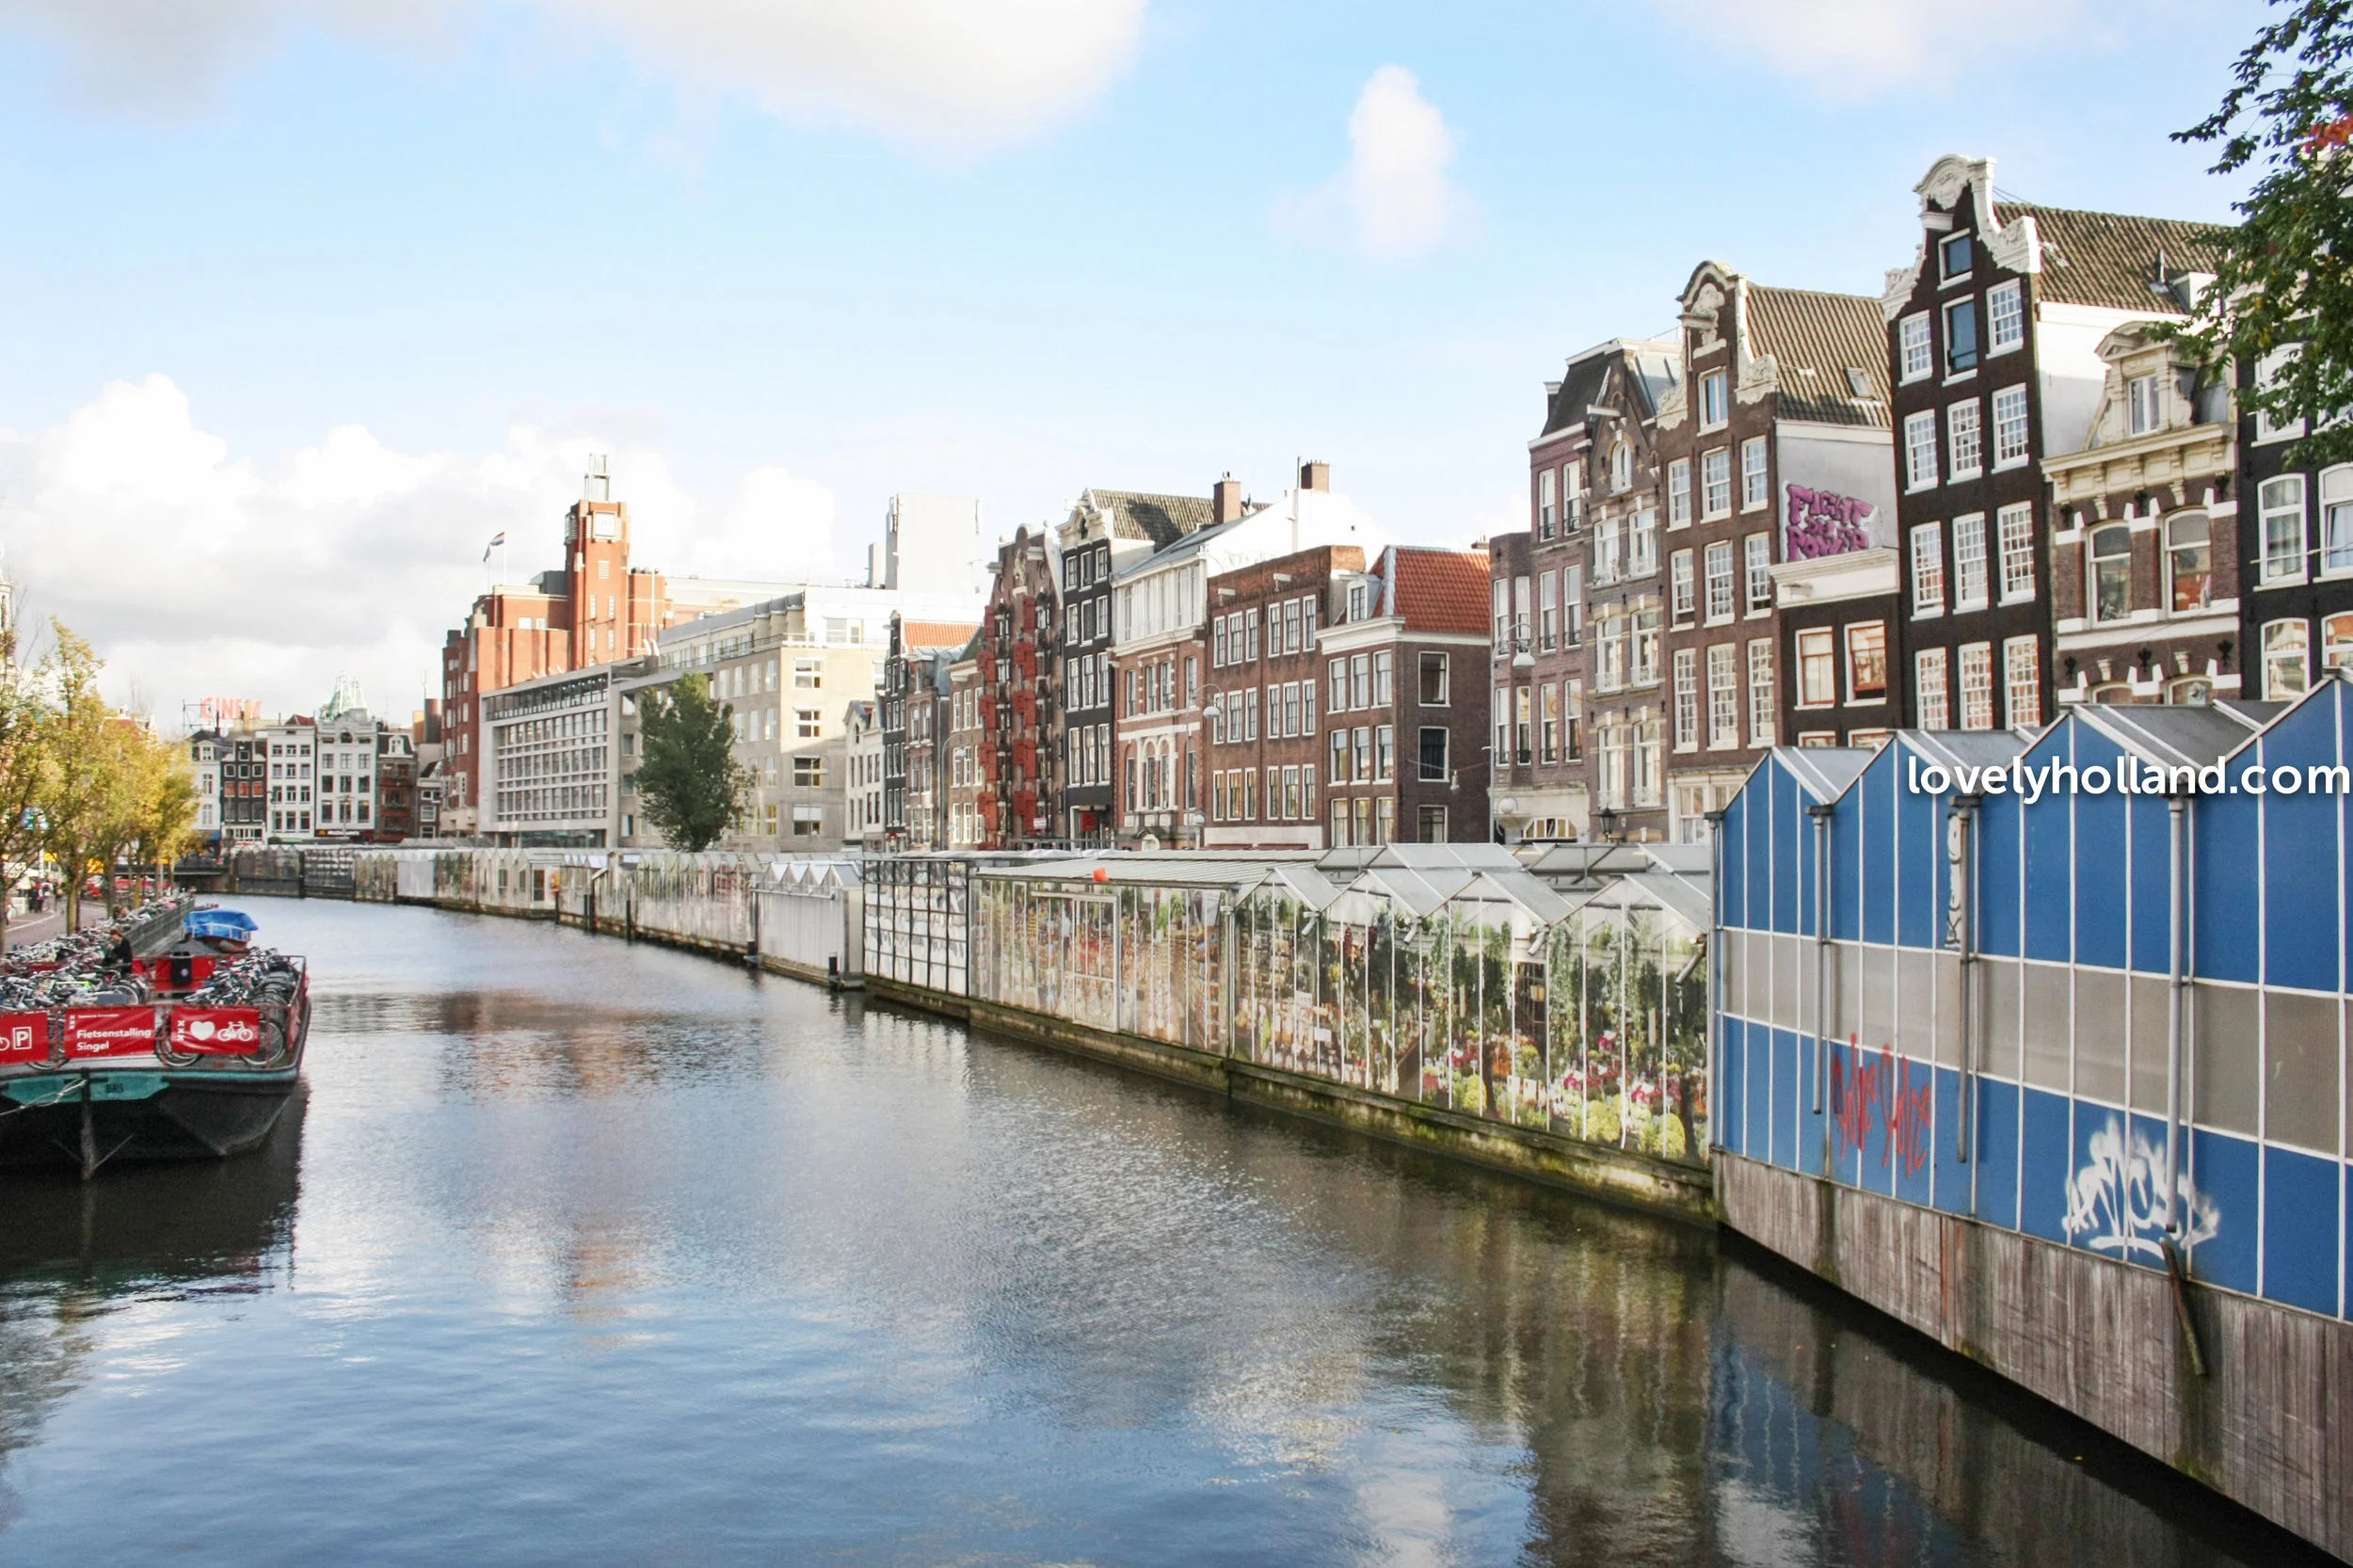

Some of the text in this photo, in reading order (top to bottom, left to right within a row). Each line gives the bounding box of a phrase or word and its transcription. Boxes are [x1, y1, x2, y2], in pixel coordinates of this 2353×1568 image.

[1786, 484, 1874, 527] FIGHT
[76, 1028, 152, 1039] Fietsenstalling
[77, 1041, 110, 1053] Singel
